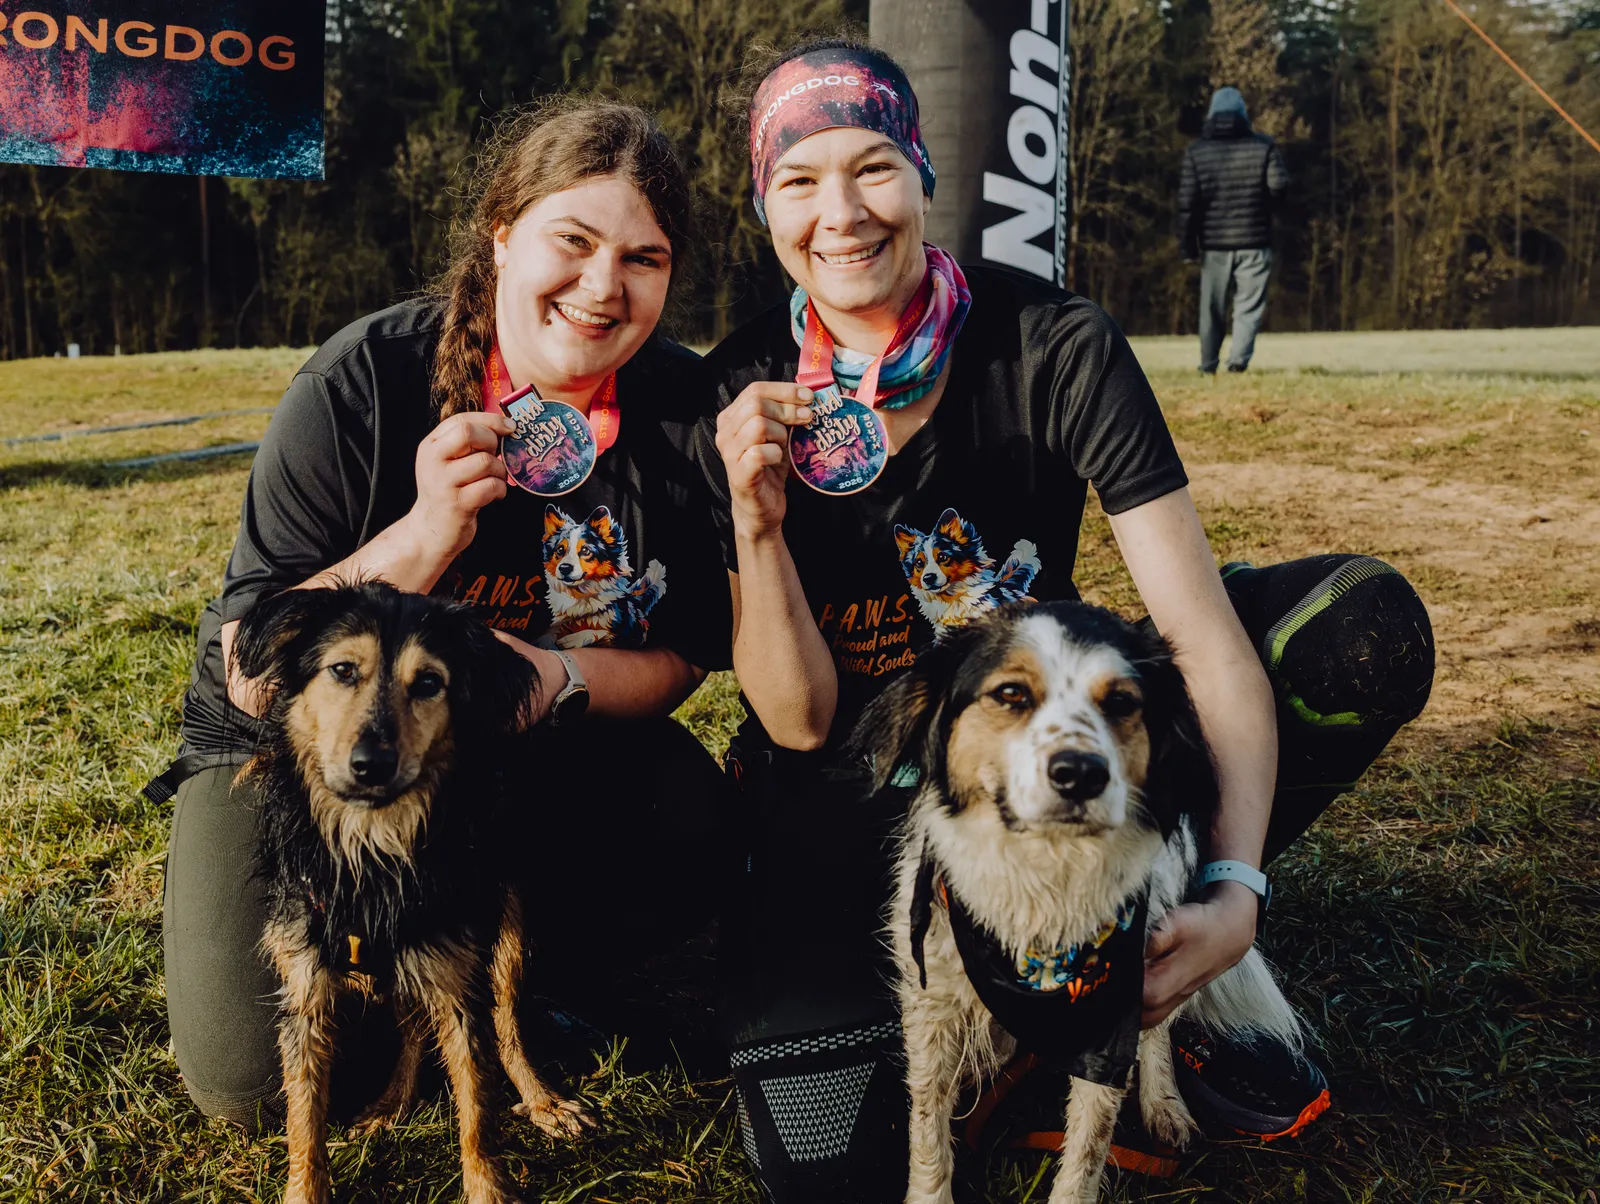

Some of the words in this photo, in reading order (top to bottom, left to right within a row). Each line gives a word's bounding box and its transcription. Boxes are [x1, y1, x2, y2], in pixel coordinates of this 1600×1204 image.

[0, 11, 296, 71] ONGDOG
[756, 75, 860, 152] STRONGDOG
[811, 318, 824, 370] ONGDOG
[525, 415, 567, 458] dirty
[565, 411, 589, 444] SOUTH
[814, 414, 861, 452] dirty
[863, 413, 881, 450] SOUTH
[558, 472, 580, 489] 2026
[839, 476, 864, 490] 2026
[819, 593, 914, 633] PA.W.S.
[879, 624, 911, 648] and
[873, 647, 917, 677] Souls
